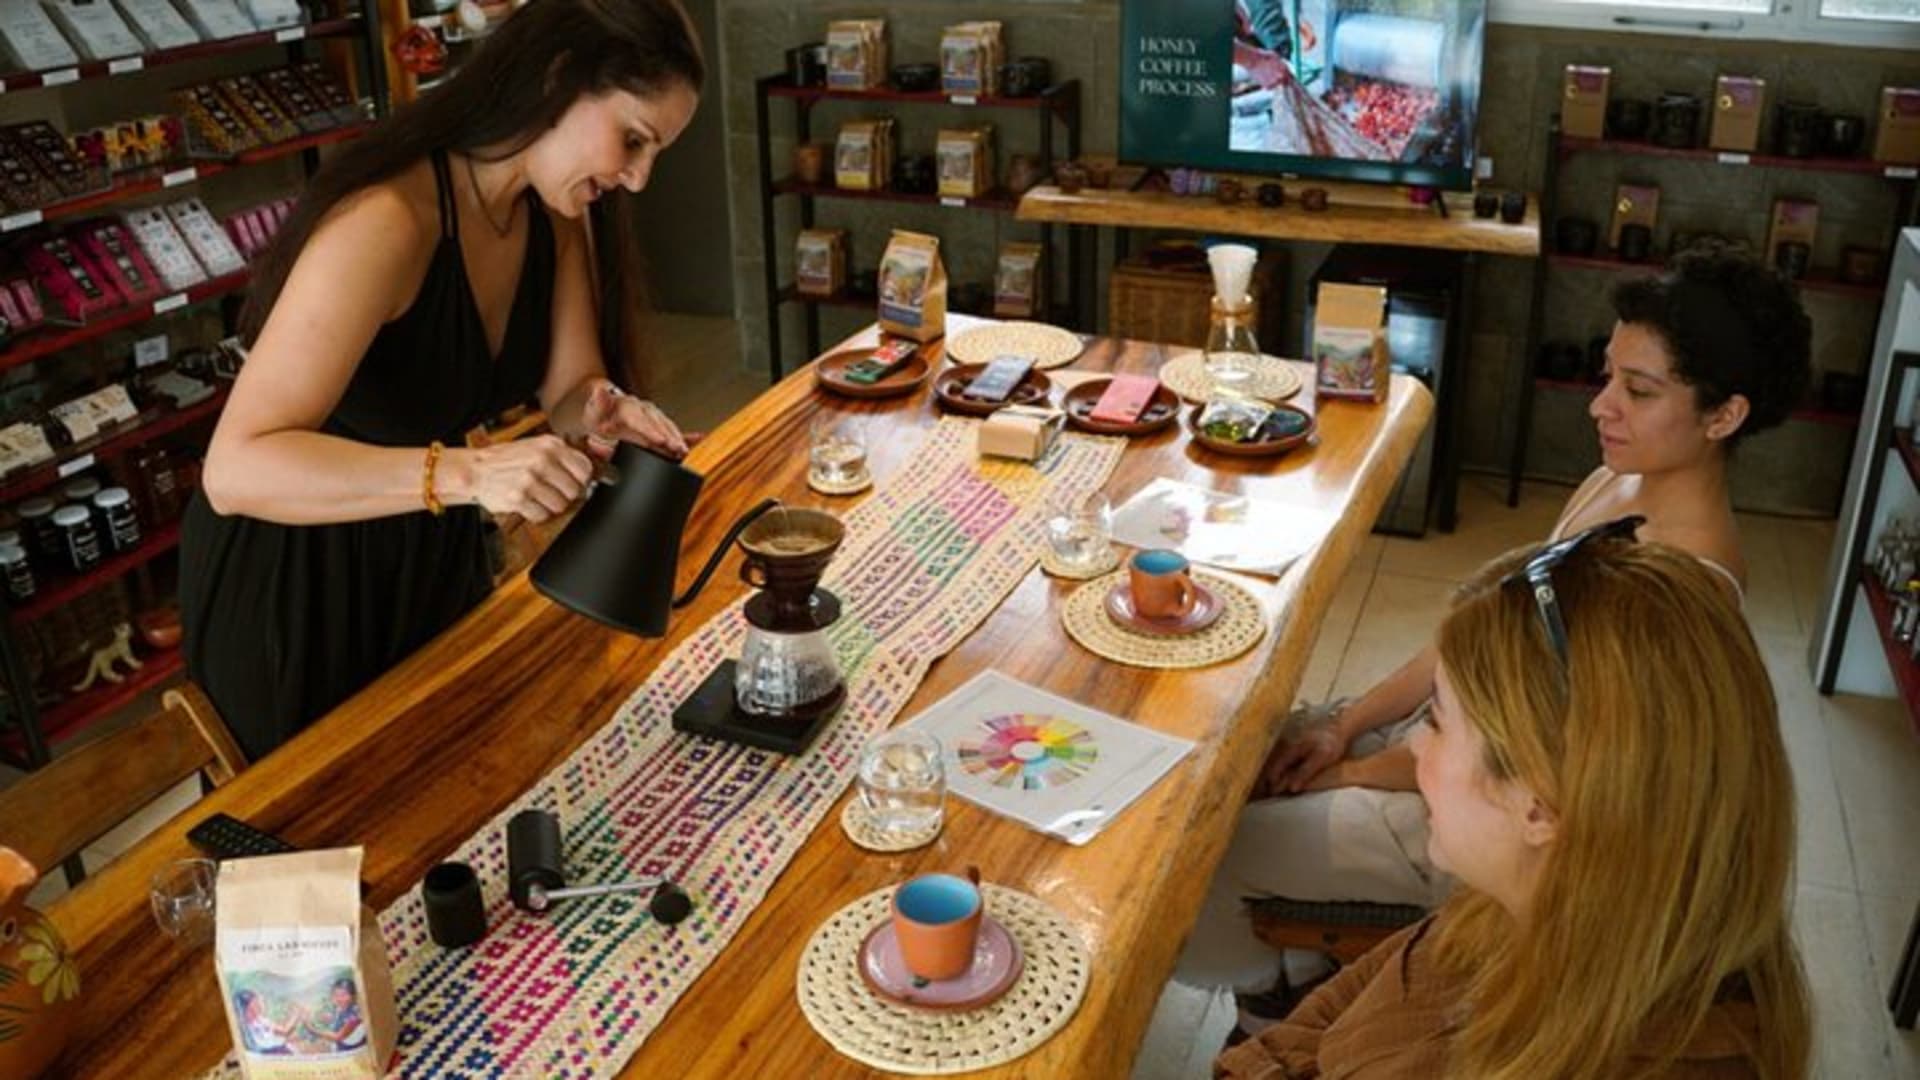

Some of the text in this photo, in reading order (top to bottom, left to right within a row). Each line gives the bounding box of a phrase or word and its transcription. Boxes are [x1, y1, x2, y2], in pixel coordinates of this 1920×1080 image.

[1140, 37, 1196, 54] HONEY
[1140, 58, 1207, 76] COFFEE
[1139, 79, 1216, 96] PROCESS
